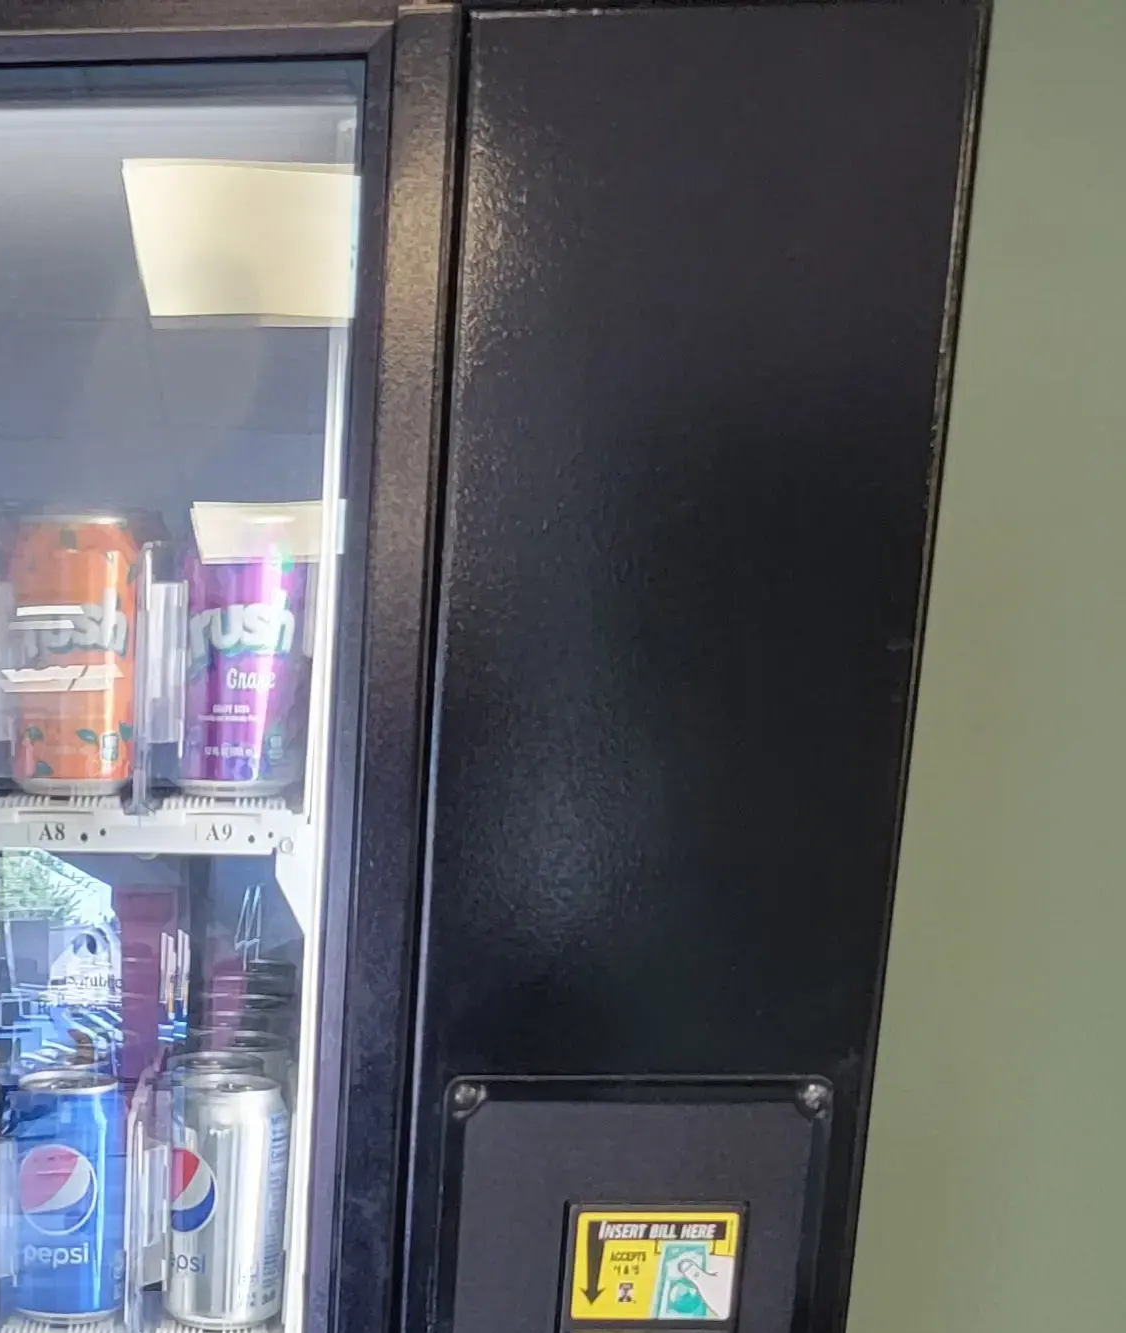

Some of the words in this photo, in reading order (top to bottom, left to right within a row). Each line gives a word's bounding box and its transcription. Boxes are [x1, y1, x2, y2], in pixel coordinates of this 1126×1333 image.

[189, 588, 296, 664] rush
[39, 822, 66, 841] A8
[205, 823, 233, 841] A9
[598, 1220, 648, 1240] INSERT
[649, 1223, 677, 1239] BILL
[680, 1223, 717, 1239] HERE
[23, 1241, 90, 1270] pepsi
[171, 1253, 197, 1275] psi
[609, 1250, 647, 1262] ACCEPTS
